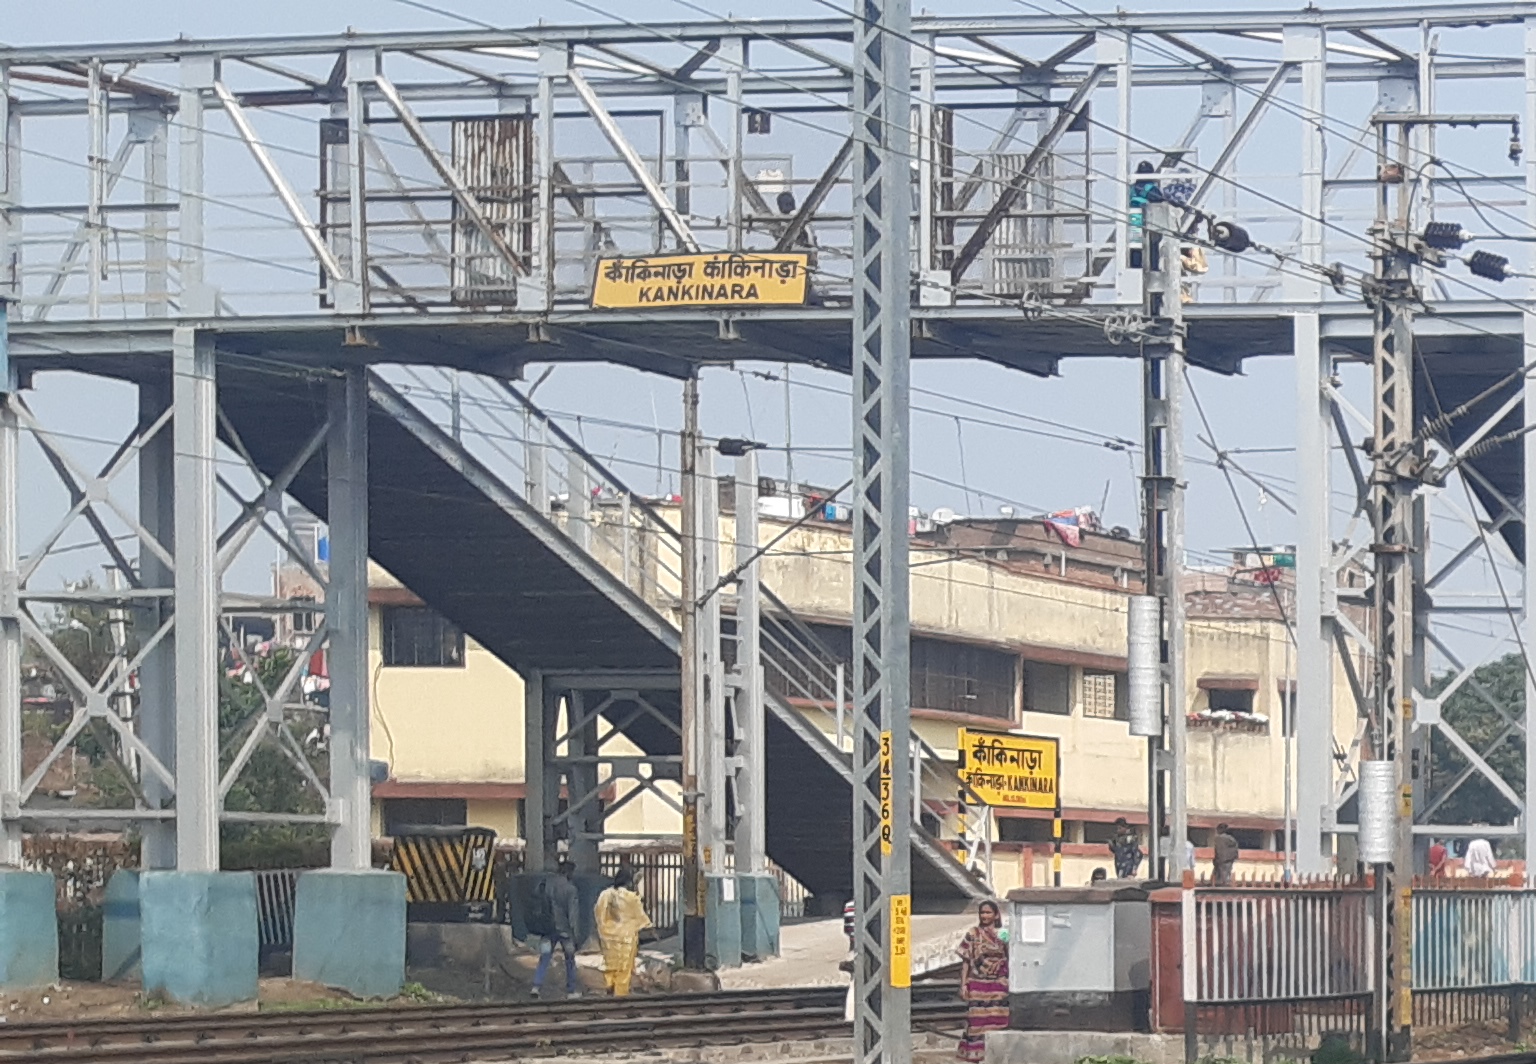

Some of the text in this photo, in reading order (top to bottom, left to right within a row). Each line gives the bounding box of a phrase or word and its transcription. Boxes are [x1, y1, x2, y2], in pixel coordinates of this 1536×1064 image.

[604, 257, 695, 285] কাঁকিনাড়া
[638, 284, 759, 302] KANKINARA
[972, 737, 1043, 775] কাঁকিনাড়া
[1007, 775, 1054, 794] KANKINARA
